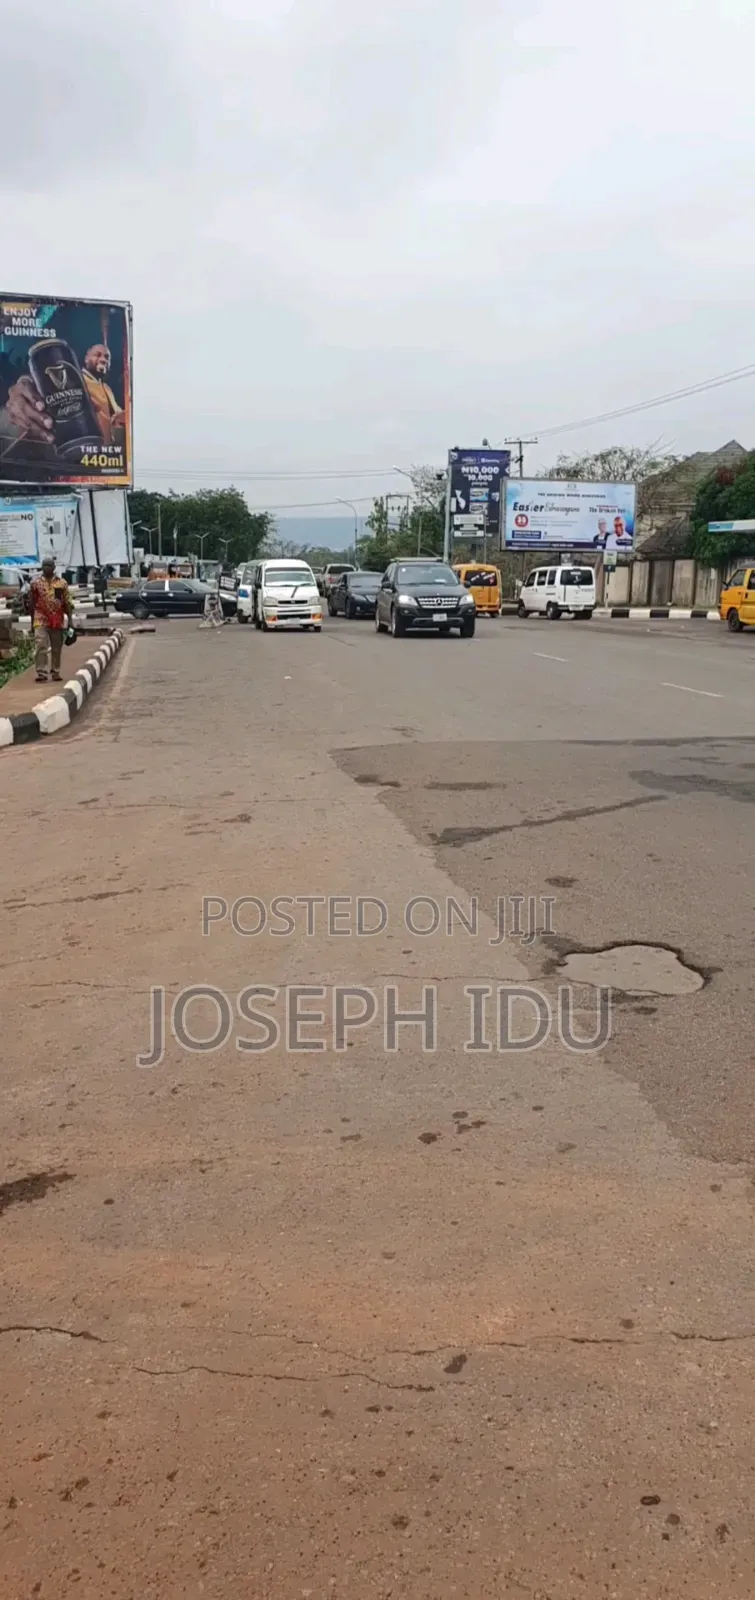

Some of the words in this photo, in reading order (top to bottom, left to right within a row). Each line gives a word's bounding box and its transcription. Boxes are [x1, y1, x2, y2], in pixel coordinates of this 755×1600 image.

[3, 307, 37, 317] ENJOY
[12, 317, 42, 327] MORE
[4, 327, 57, 338] GUINNESS
[80, 445, 98, 453] THE
[101, 445, 122, 453] NEW
[80, 454, 124, 467] 440ml
